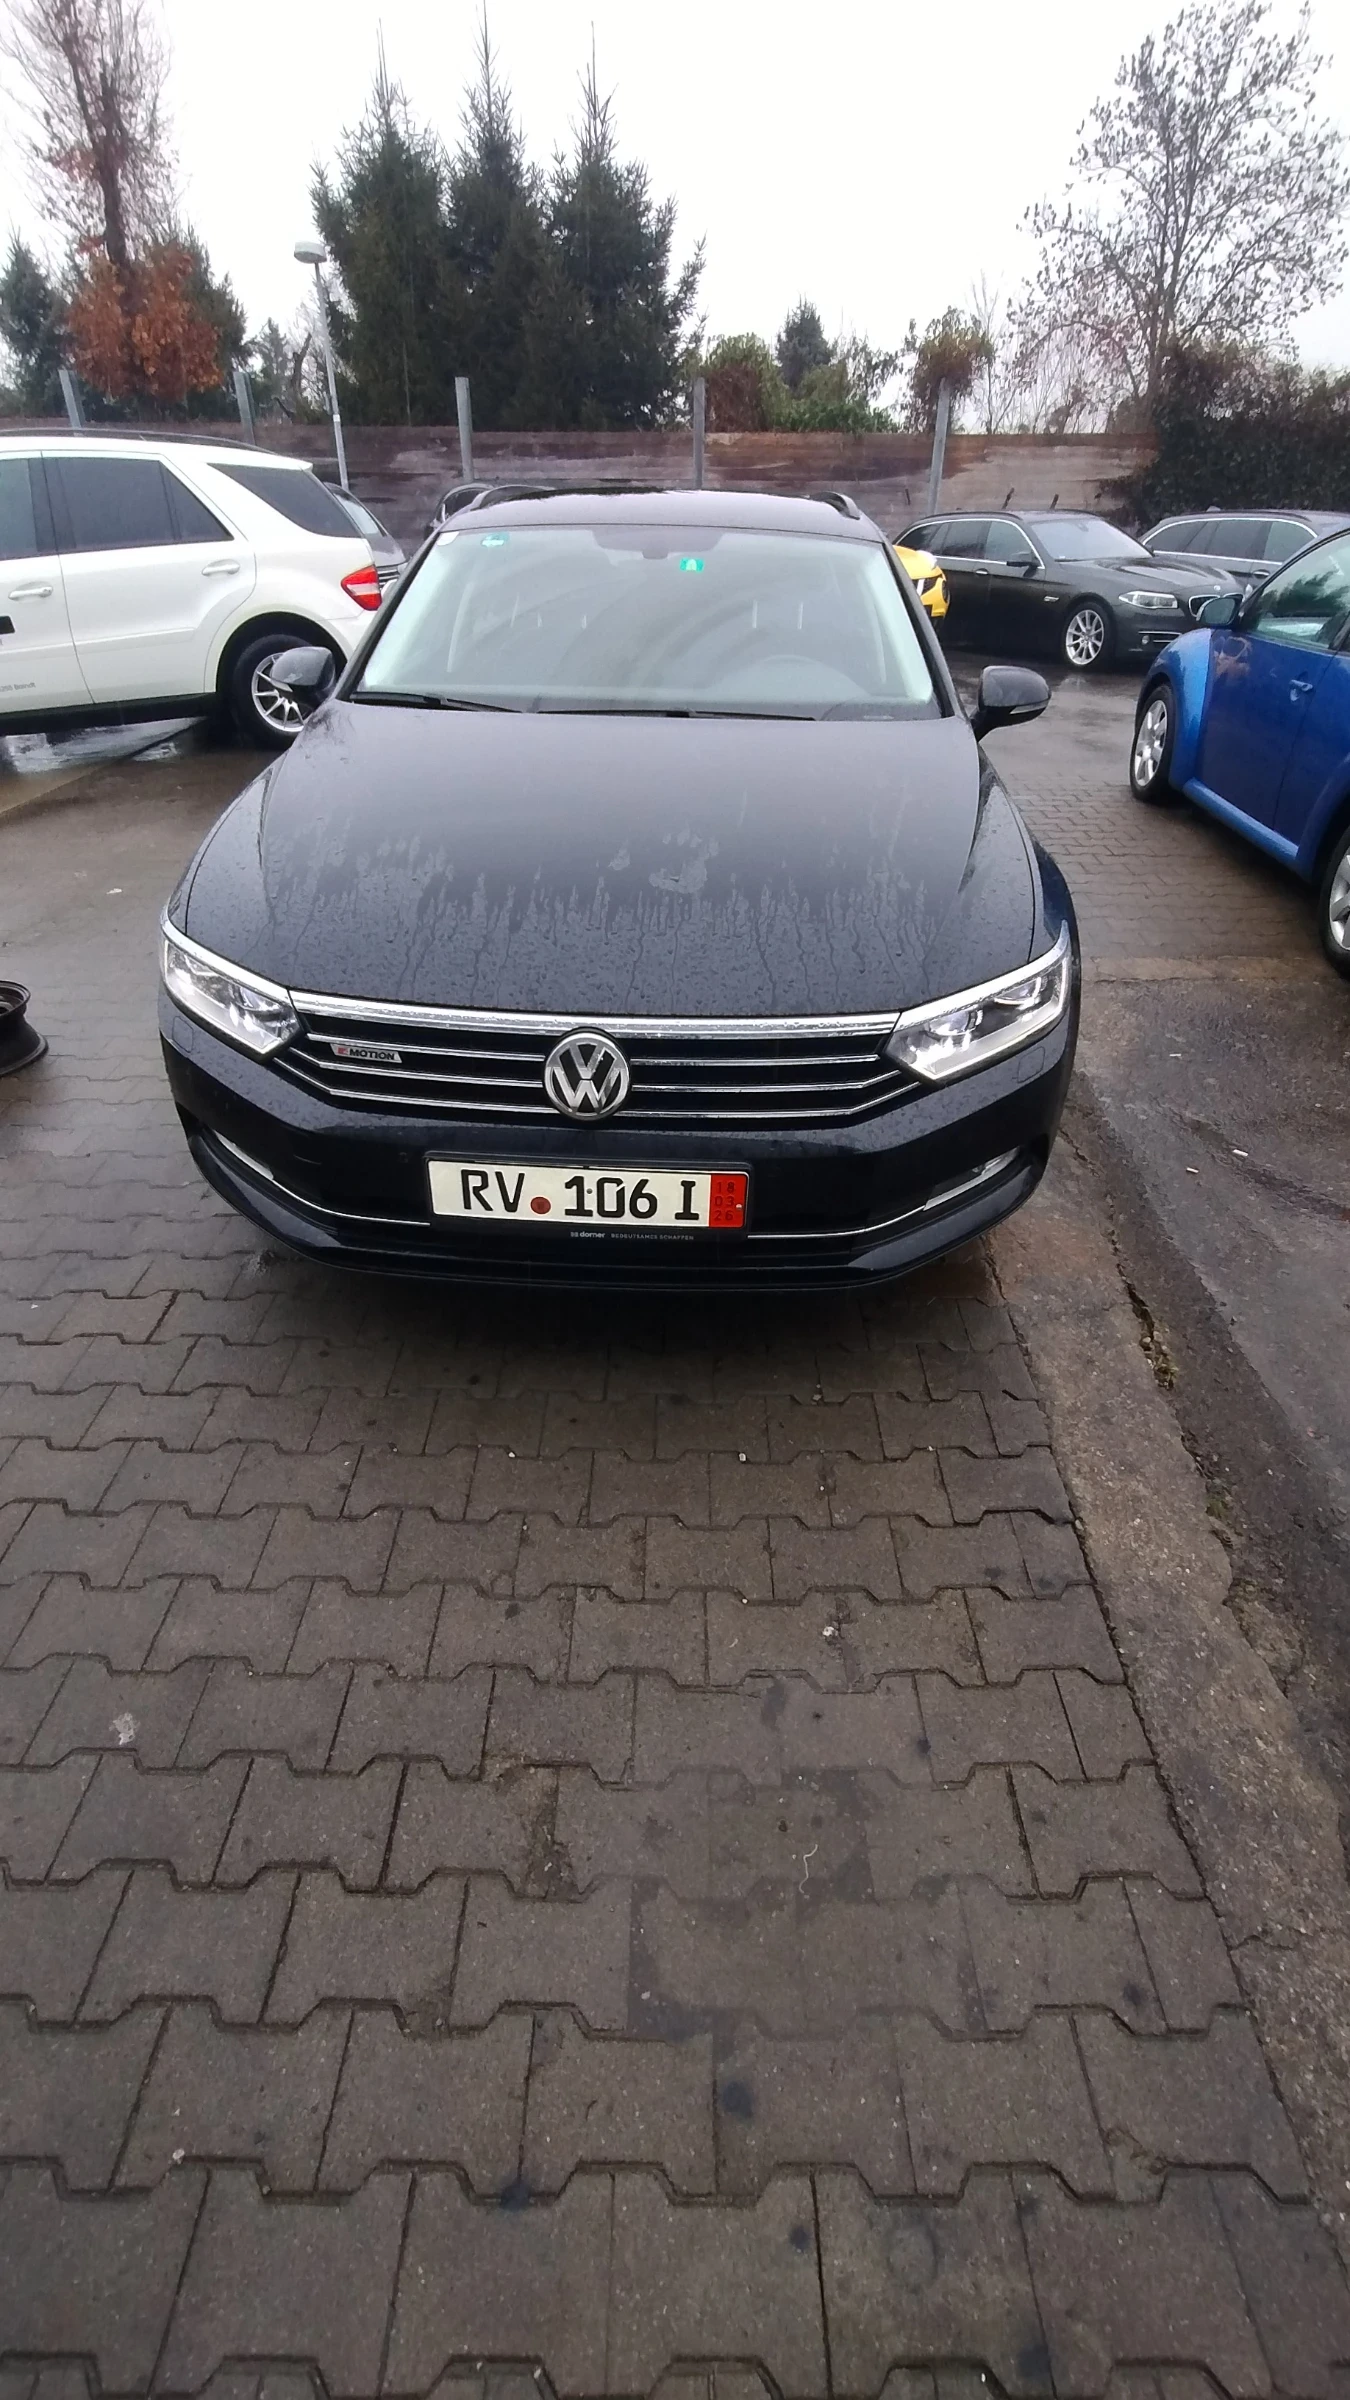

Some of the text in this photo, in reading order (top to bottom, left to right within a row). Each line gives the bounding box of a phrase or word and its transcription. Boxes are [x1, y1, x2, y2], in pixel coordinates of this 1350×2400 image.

[716, 1181, 735, 1194] 18
[461, 1169, 700, 1221] RV 106 I
[714, 1195, 735, 1207] 03
[714, 1209, 734, 1221] 26
